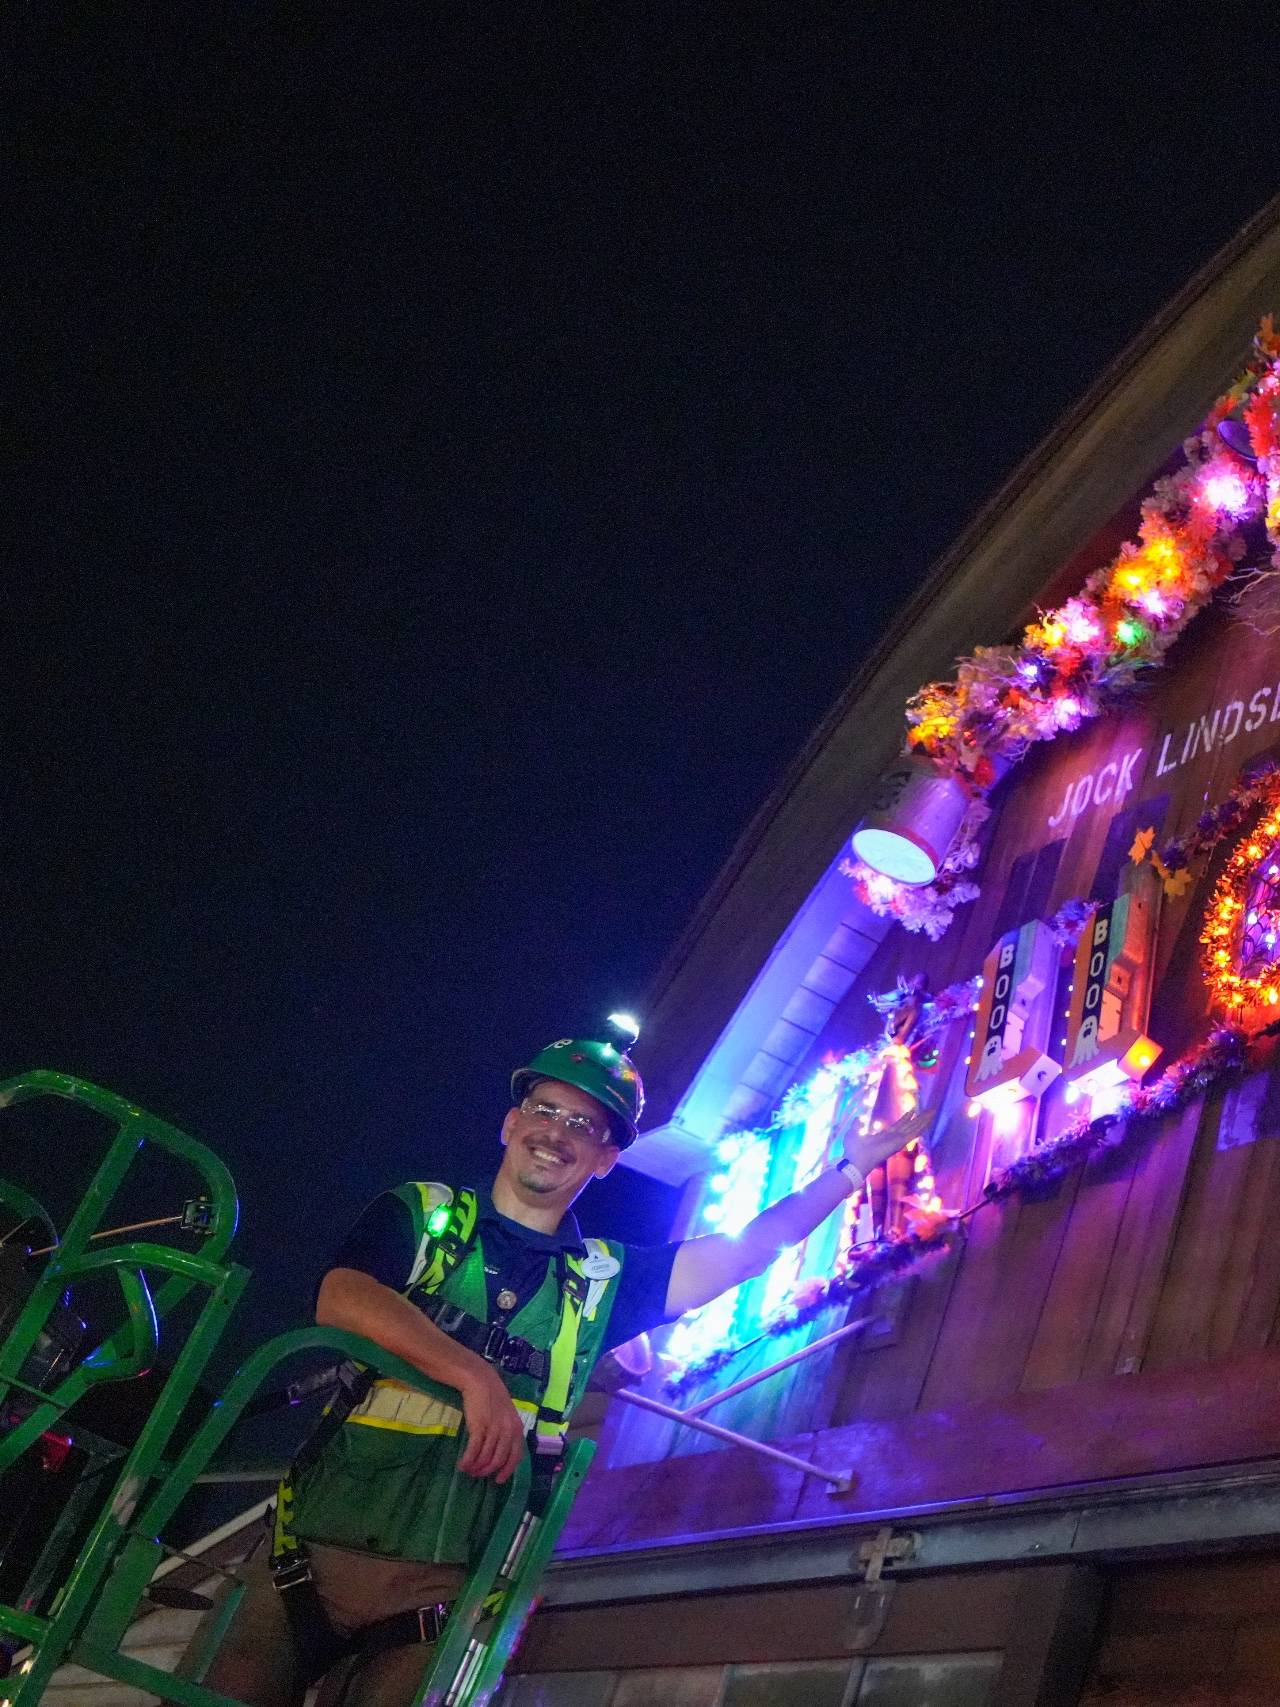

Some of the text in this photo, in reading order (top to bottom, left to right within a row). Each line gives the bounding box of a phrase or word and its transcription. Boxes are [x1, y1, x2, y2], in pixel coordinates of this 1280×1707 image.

[1047, 747, 1143, 828] JOCK
[990, 943, 1015, 1030] BOO
[1085, 918, 1109, 1010] BOO
